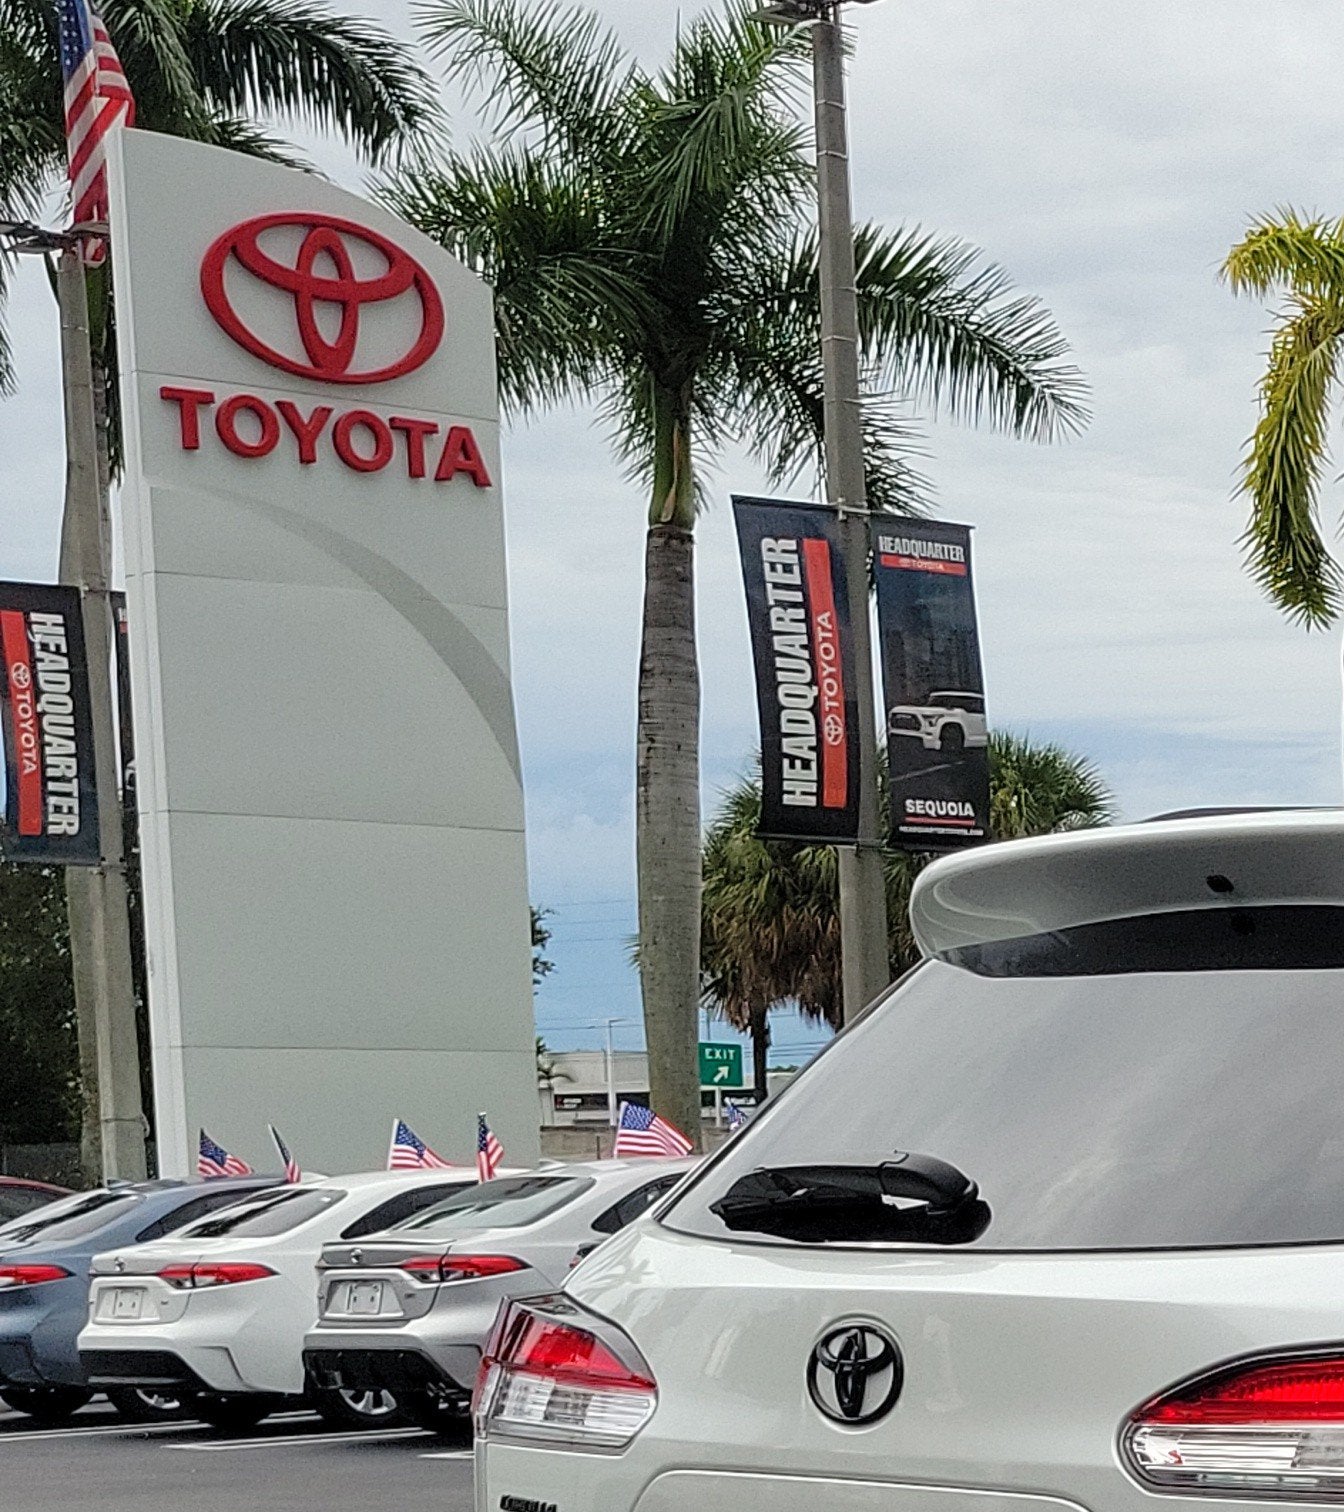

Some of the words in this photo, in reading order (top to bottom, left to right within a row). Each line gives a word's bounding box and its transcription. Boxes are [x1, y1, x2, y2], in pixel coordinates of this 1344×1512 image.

[160, 386, 493, 488] TOYOTA
[878, 535, 965, 563] HEADQUARTER
[761, 537, 818, 808] HEADQUARTER
[816, 611, 843, 712] TOYOTA
[16, 690, 39, 776] TOYOTA
[29, 612, 80, 837] HEADQUARTER
[905, 799, 975, 817] SEQUOIA
[704, 1048, 736, 1060] EXIT
